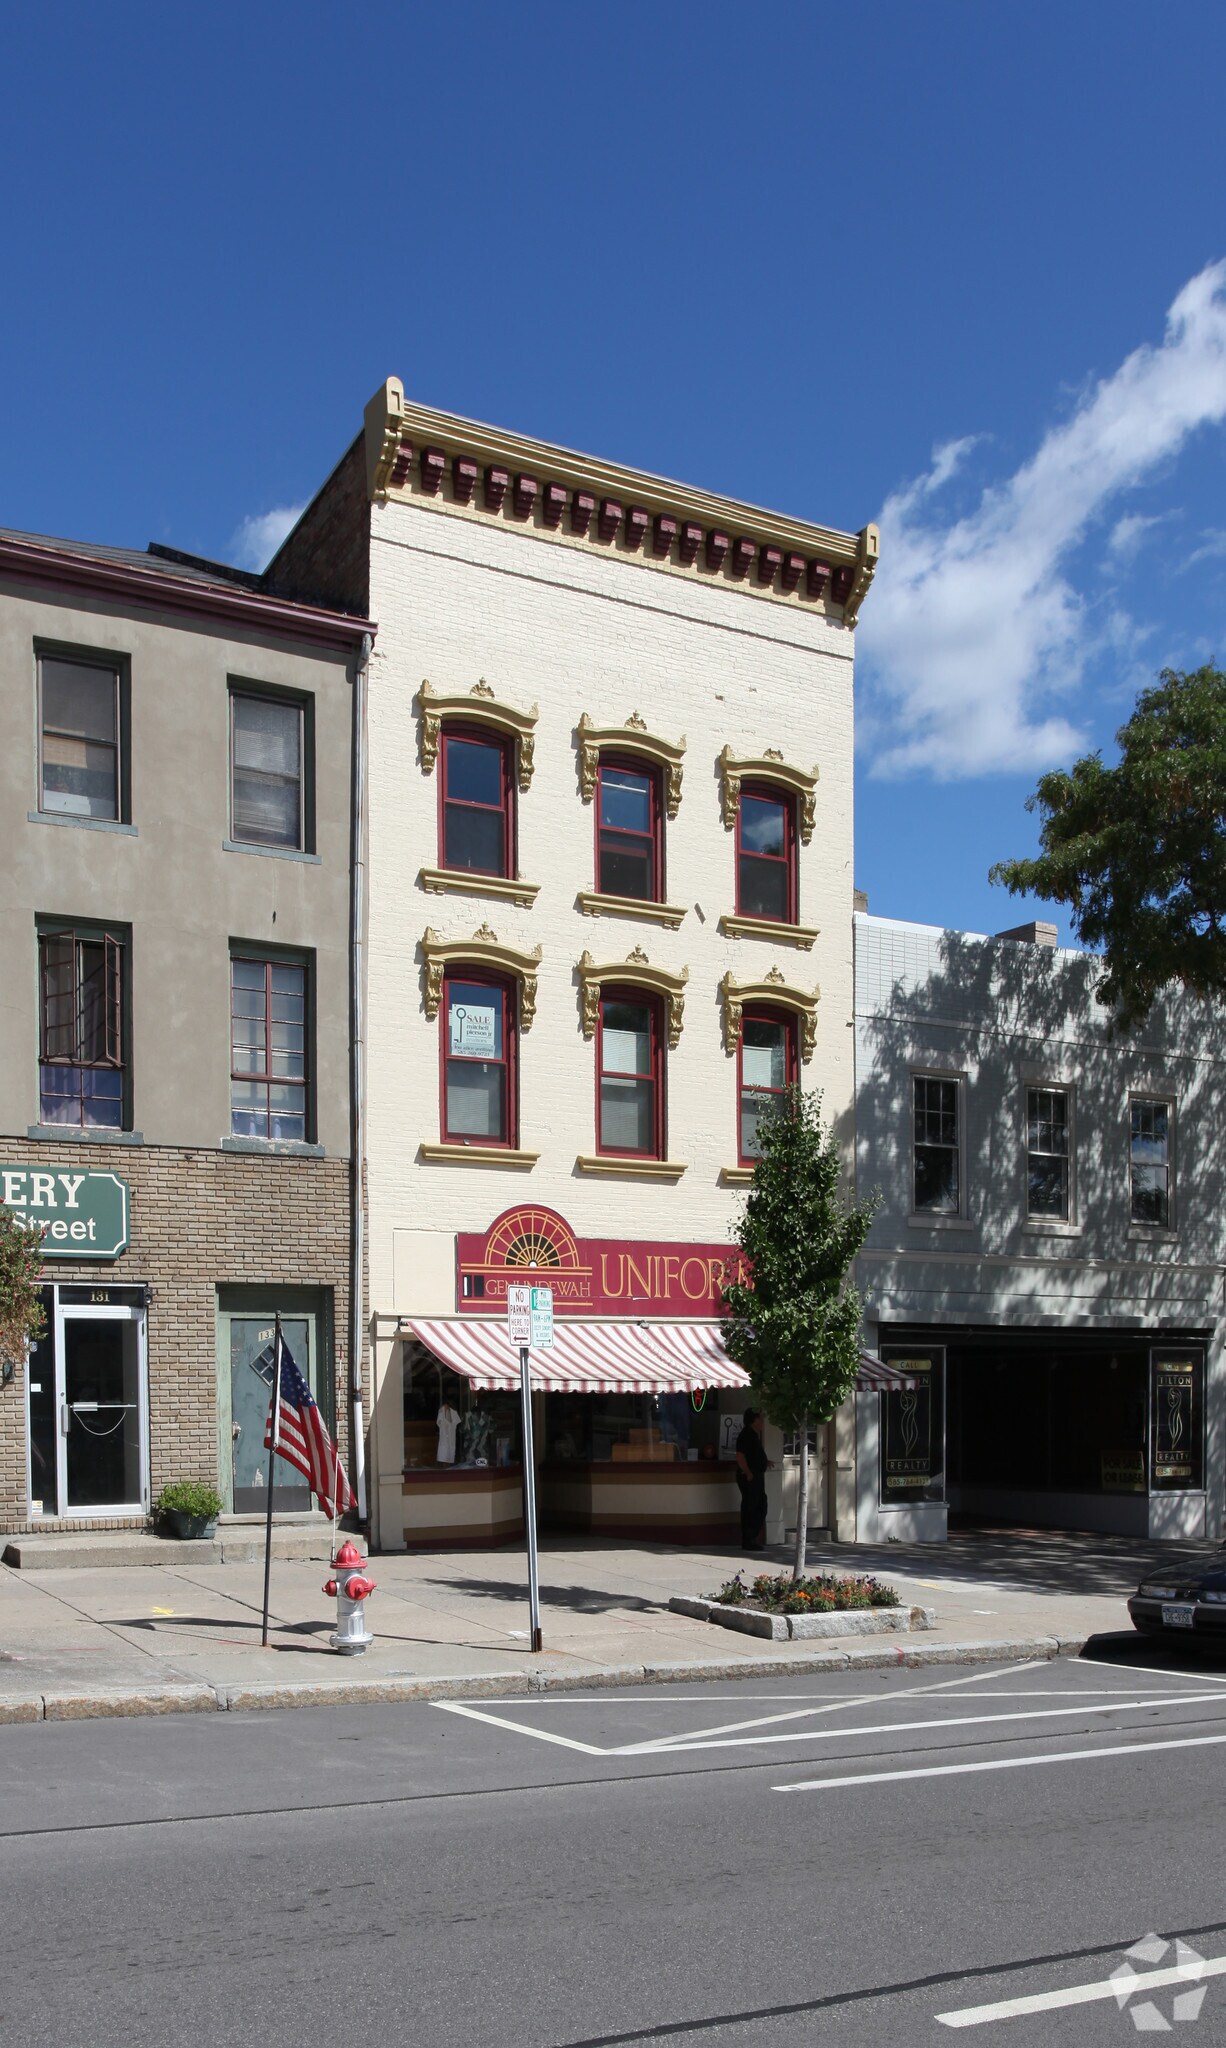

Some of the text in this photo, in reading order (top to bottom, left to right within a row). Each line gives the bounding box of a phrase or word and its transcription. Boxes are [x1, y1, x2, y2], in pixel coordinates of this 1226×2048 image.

[466, 1014, 490, 1024] SALE
[12, 1211, 96, 1241] Street
[90, 1291, 110, 1302] 131
[515, 1290, 524, 1303] NO
[510, 1304, 530, 1316] PARKING
[511, 1318, 529, 1327] HERE TO
[260, 1329, 275, 1340] 133
[511, 1327, 529, 1336] CORNER
[900, 1361, 918, 1369] CALL
[1160, 1376, 1191, 1385] TILTON
[1158, 1453, 1189, 1461] REALTY
[890, 1461, 928, 1470] REALTY
